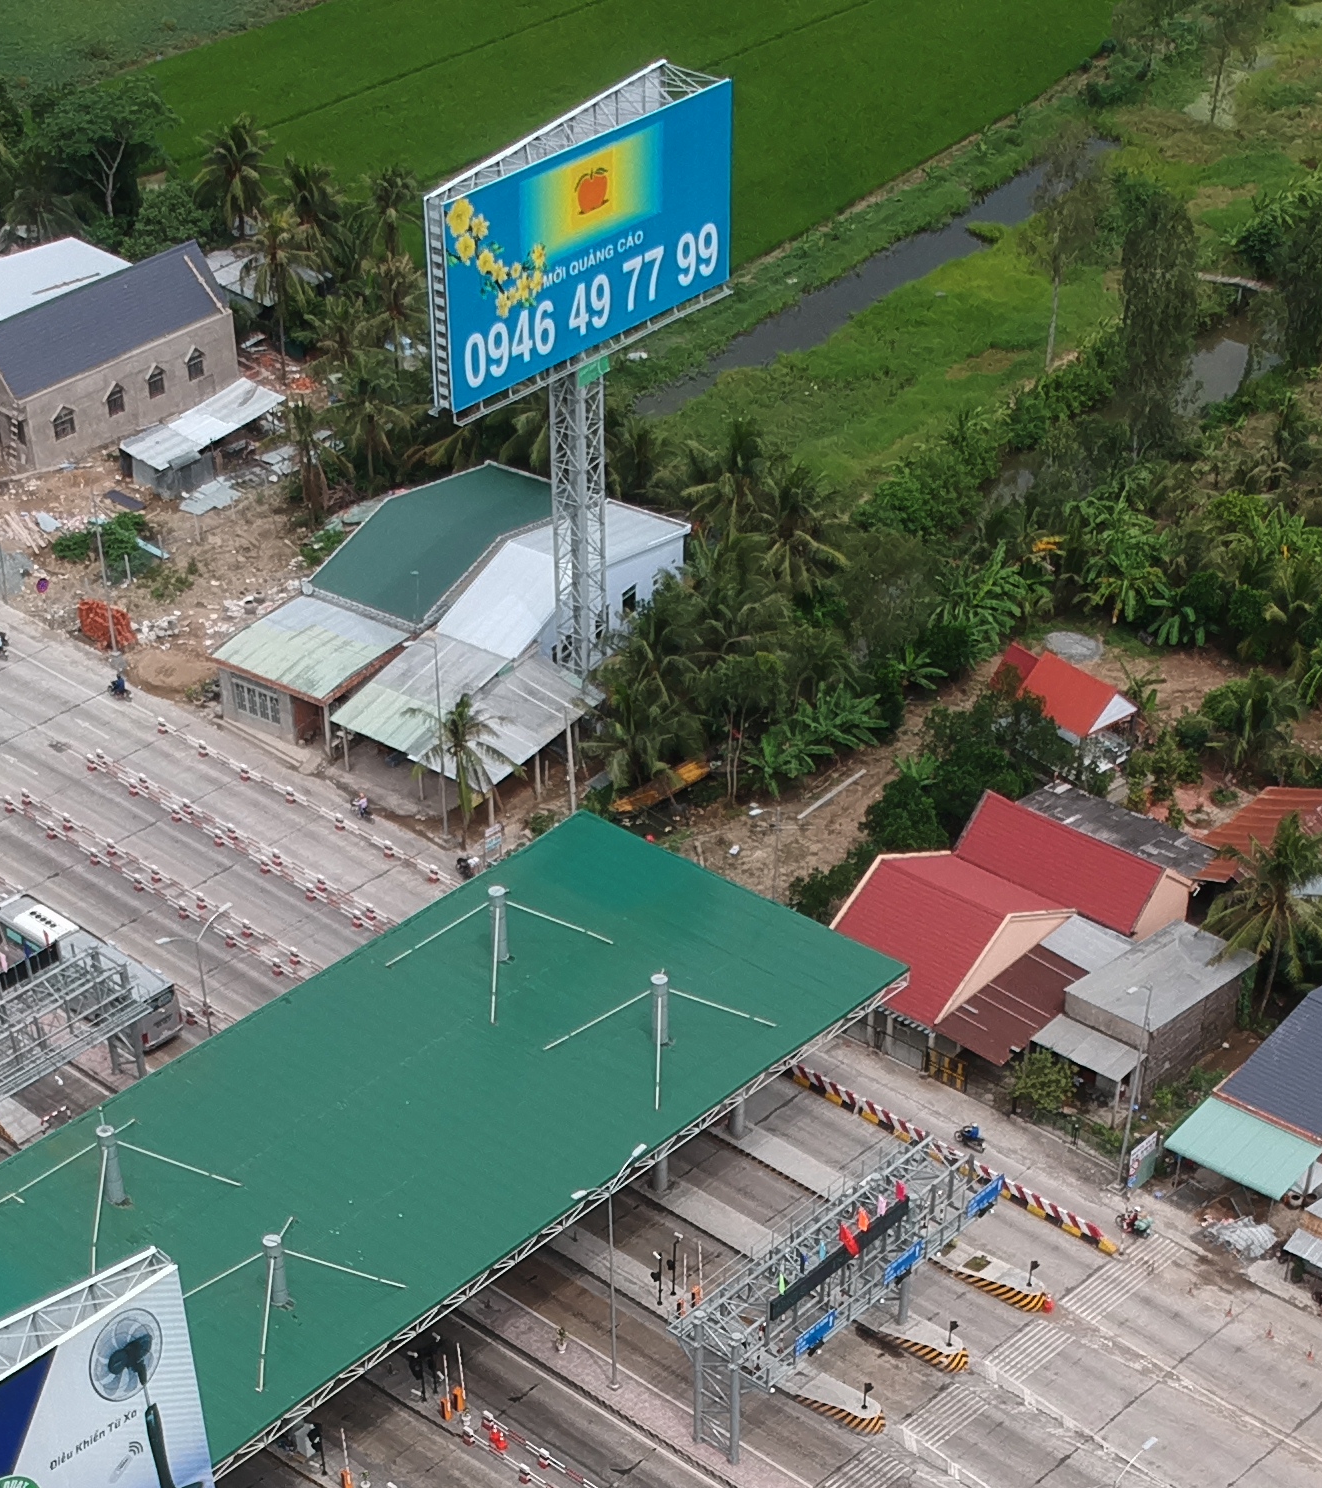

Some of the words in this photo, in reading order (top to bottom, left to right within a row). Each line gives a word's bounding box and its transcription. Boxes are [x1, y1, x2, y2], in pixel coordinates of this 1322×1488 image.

[464, 300, 556, 388] 0946
[568, 273, 611, 336] 49
[622, 245, 665, 312] 77
[676, 223, 719, 287] 99
[569, 244, 614, 275] QUẢNG
